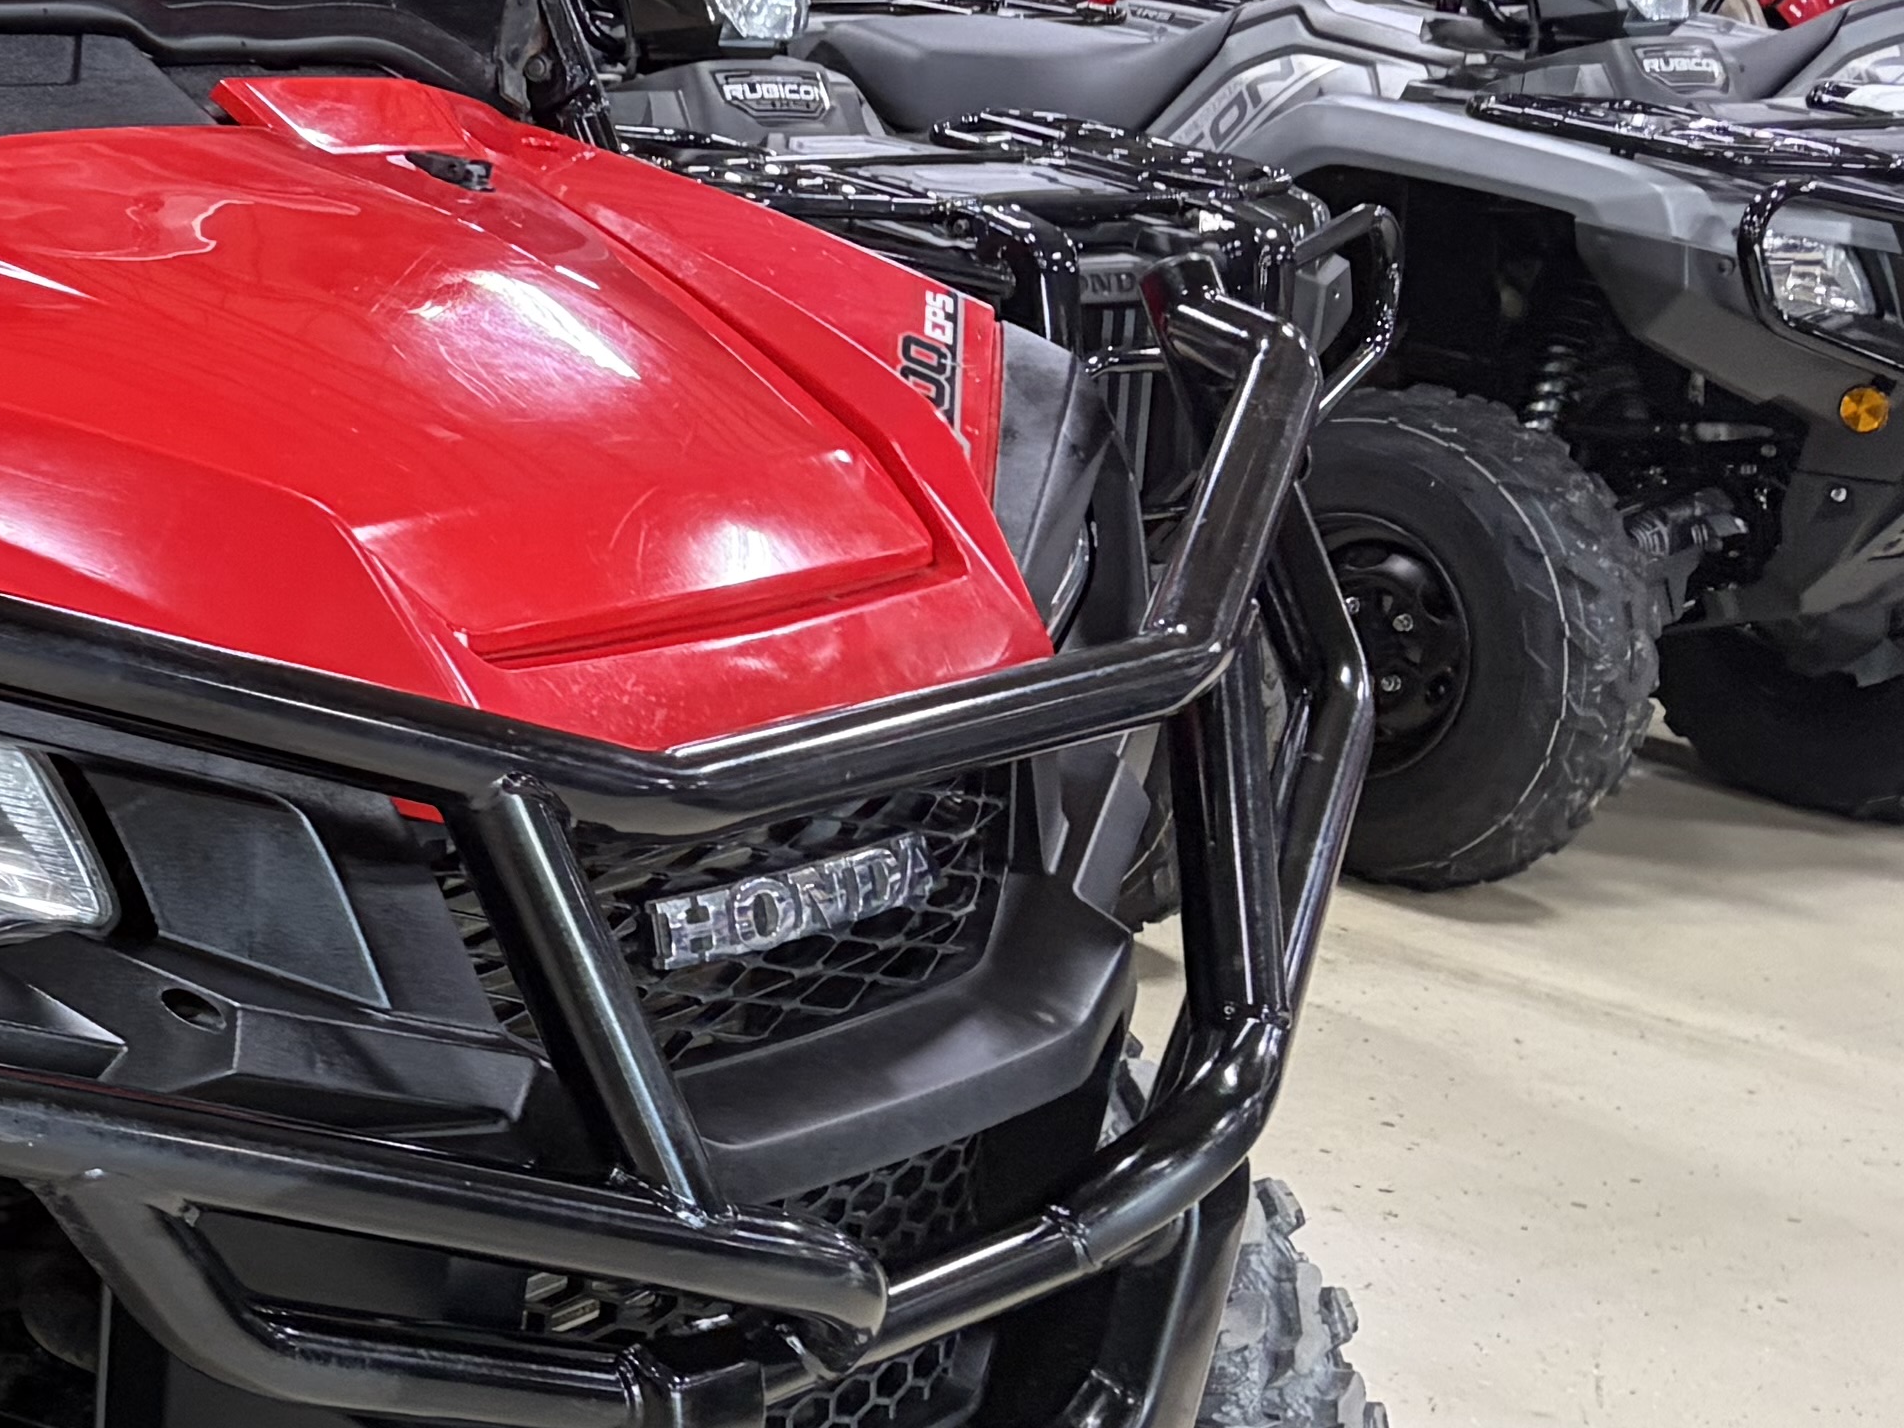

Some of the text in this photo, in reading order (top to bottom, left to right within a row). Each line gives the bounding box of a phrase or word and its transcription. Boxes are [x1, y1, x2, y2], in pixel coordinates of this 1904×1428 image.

[722, 82, 824, 103] RUBICON
[1190, 56, 1296, 152] ON
[924, 288, 955, 346] EPS
[646, 833, 935, 971] HONDA
